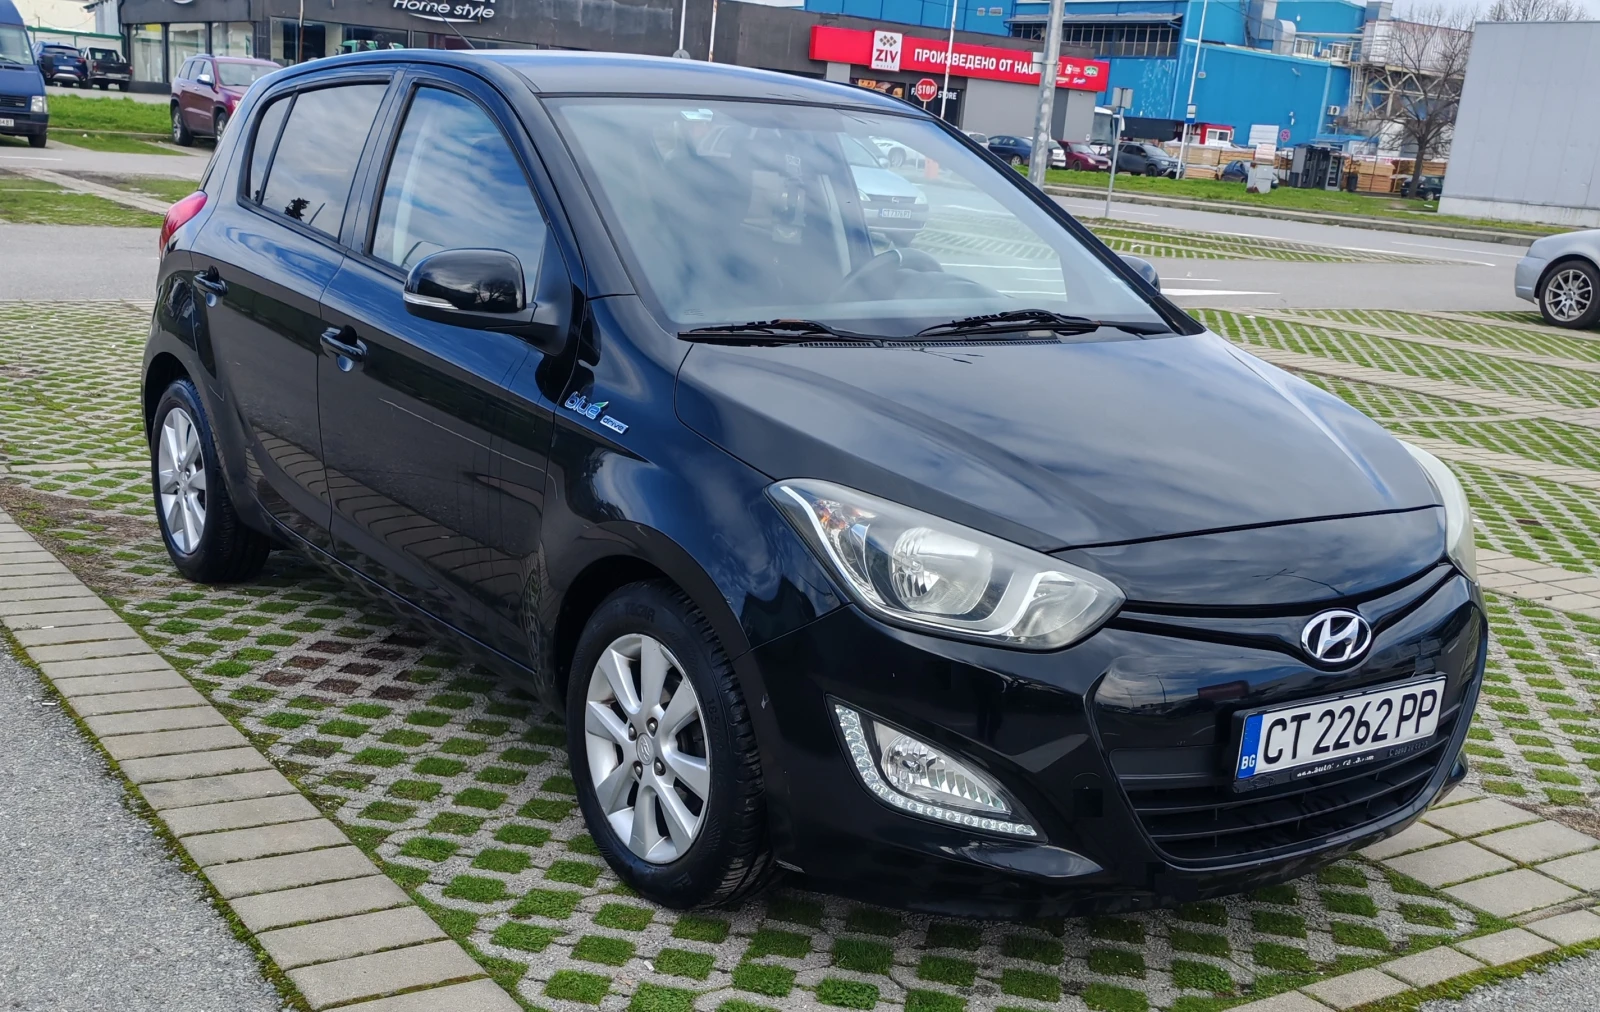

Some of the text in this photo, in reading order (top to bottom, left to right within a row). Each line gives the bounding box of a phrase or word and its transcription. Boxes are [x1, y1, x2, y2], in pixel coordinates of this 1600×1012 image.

[393, 0, 495, 19] Home style
[875, 48, 898, 63] ZIV
[998, 59, 1014, 73] ОТ
[917, 85, 935, 96] STOP
[564, 390, 601, 420] blue
[602, 416, 625, 432] drive
[1263, 689, 1437, 765] CT 2262 PP
[1241, 754, 1256, 770] BG
